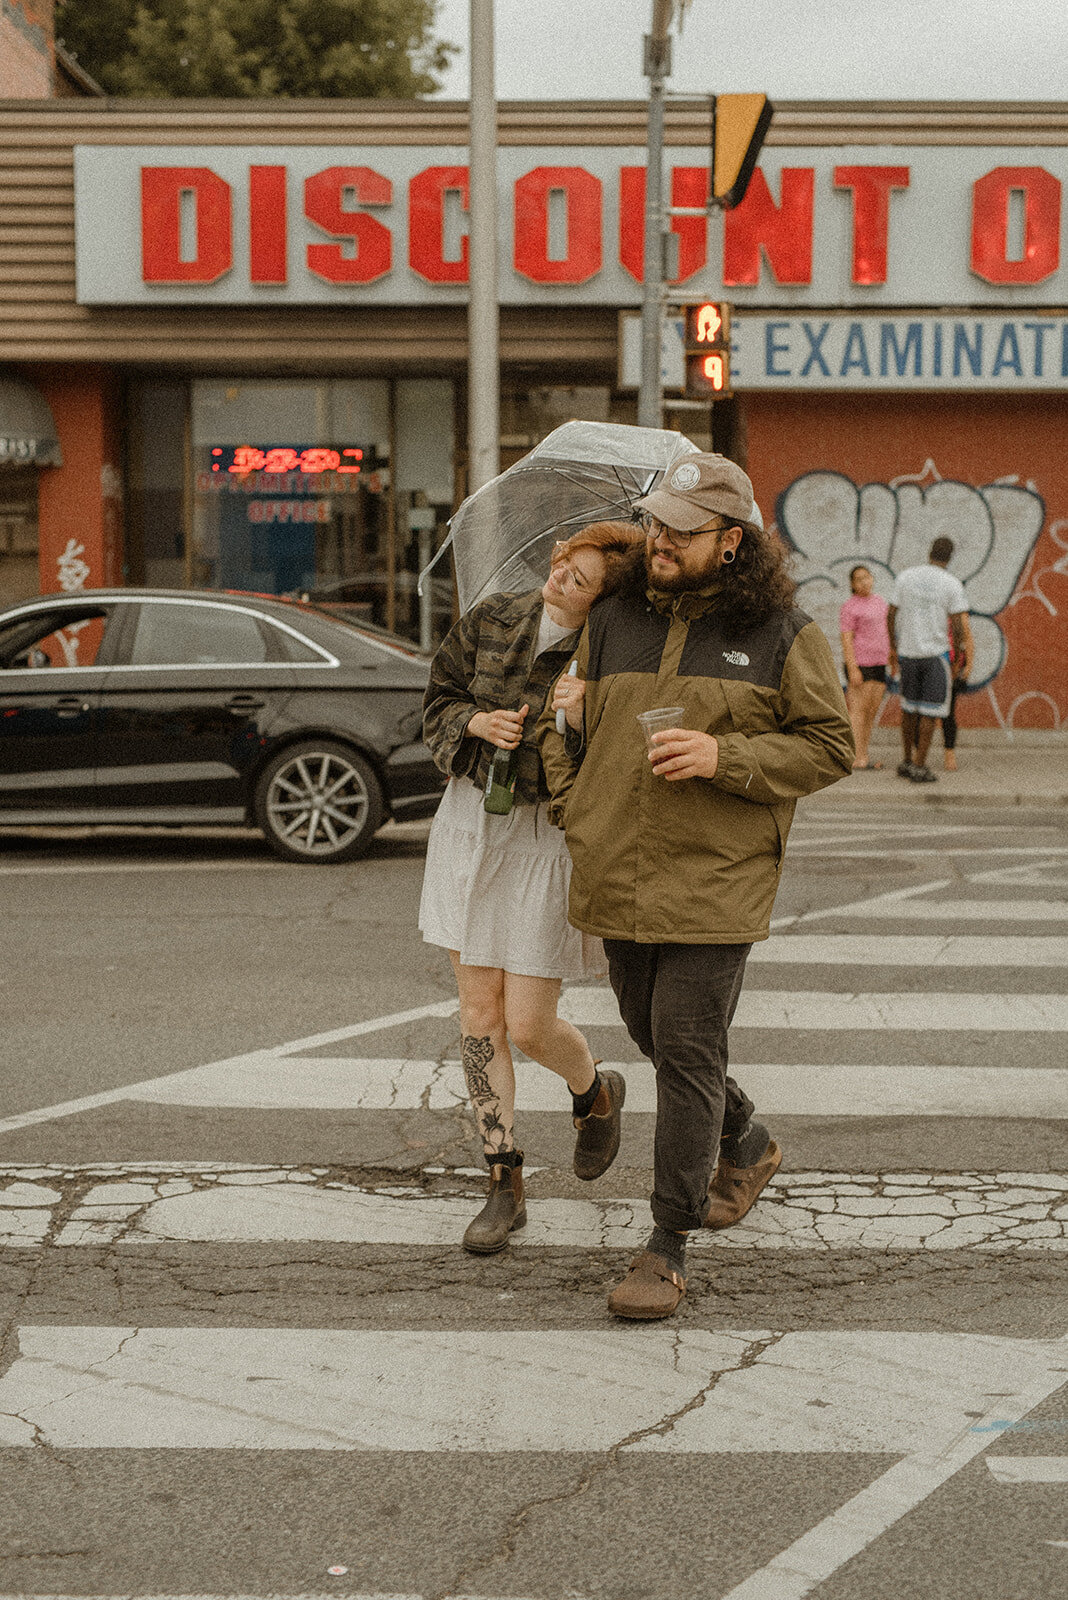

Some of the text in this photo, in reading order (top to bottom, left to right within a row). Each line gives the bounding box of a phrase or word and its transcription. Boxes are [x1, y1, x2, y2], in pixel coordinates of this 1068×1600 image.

[141, 164, 1062, 286] DISCOUNT O
[704, 356, 723, 390] 9
[248, 502, 331, 524] OFFICE
